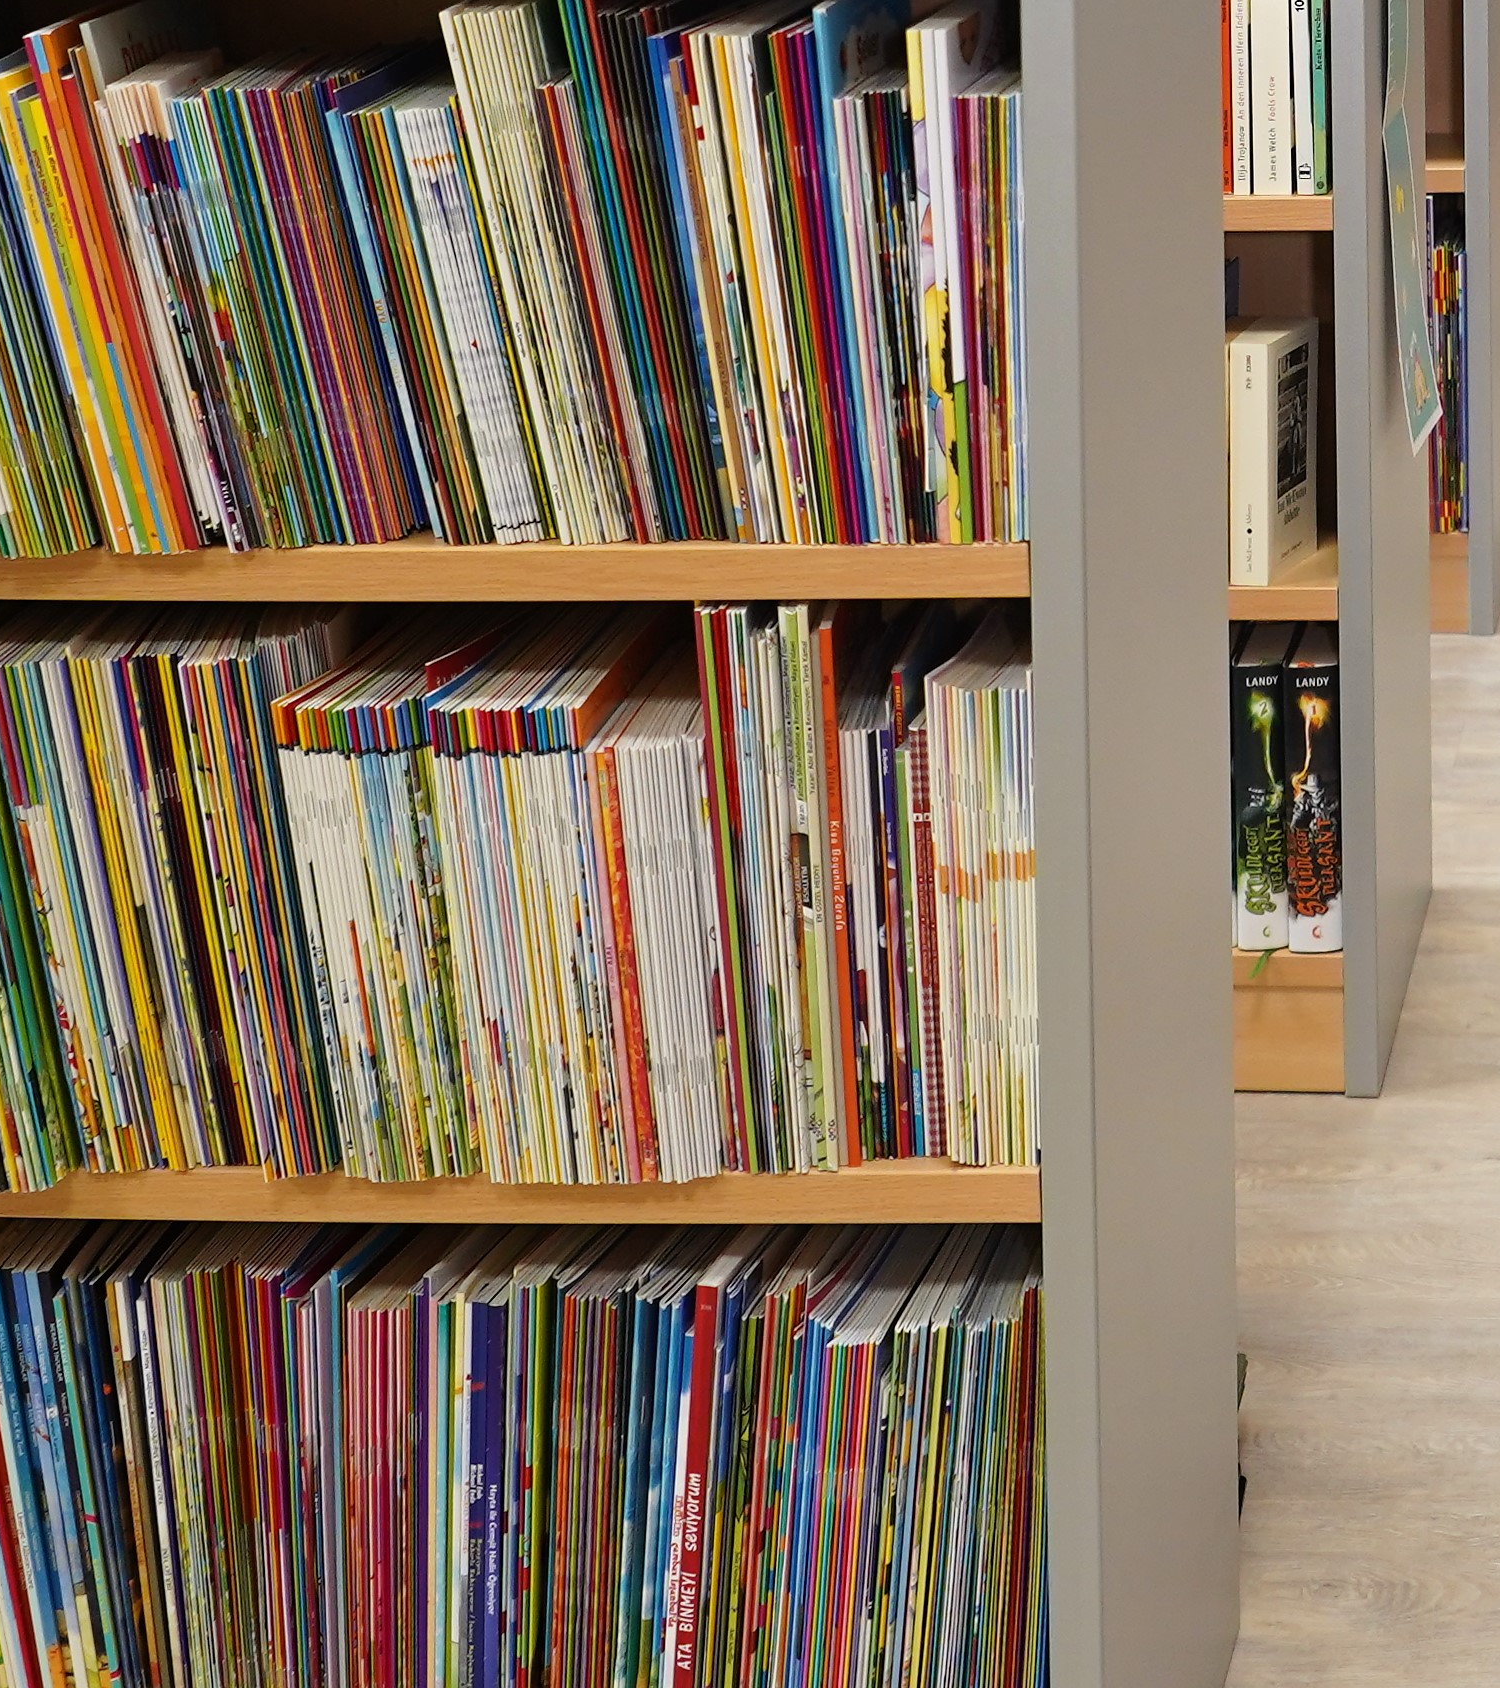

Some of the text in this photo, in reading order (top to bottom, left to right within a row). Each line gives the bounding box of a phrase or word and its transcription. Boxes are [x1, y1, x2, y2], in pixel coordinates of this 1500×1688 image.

[1294, 0, 1305, 12] 10
[1268, 76, 1277, 122] Fools Crow
[1268, 128, 1277, 181] James Welch
[1245, 675, 1279, 688] LANDY
[1296, 676, 1330, 688] LANDY
[1258, 701, 1269, 716] 2
[675, 1472, 703, 1672] ATA BİNMEYİ seviyorum
